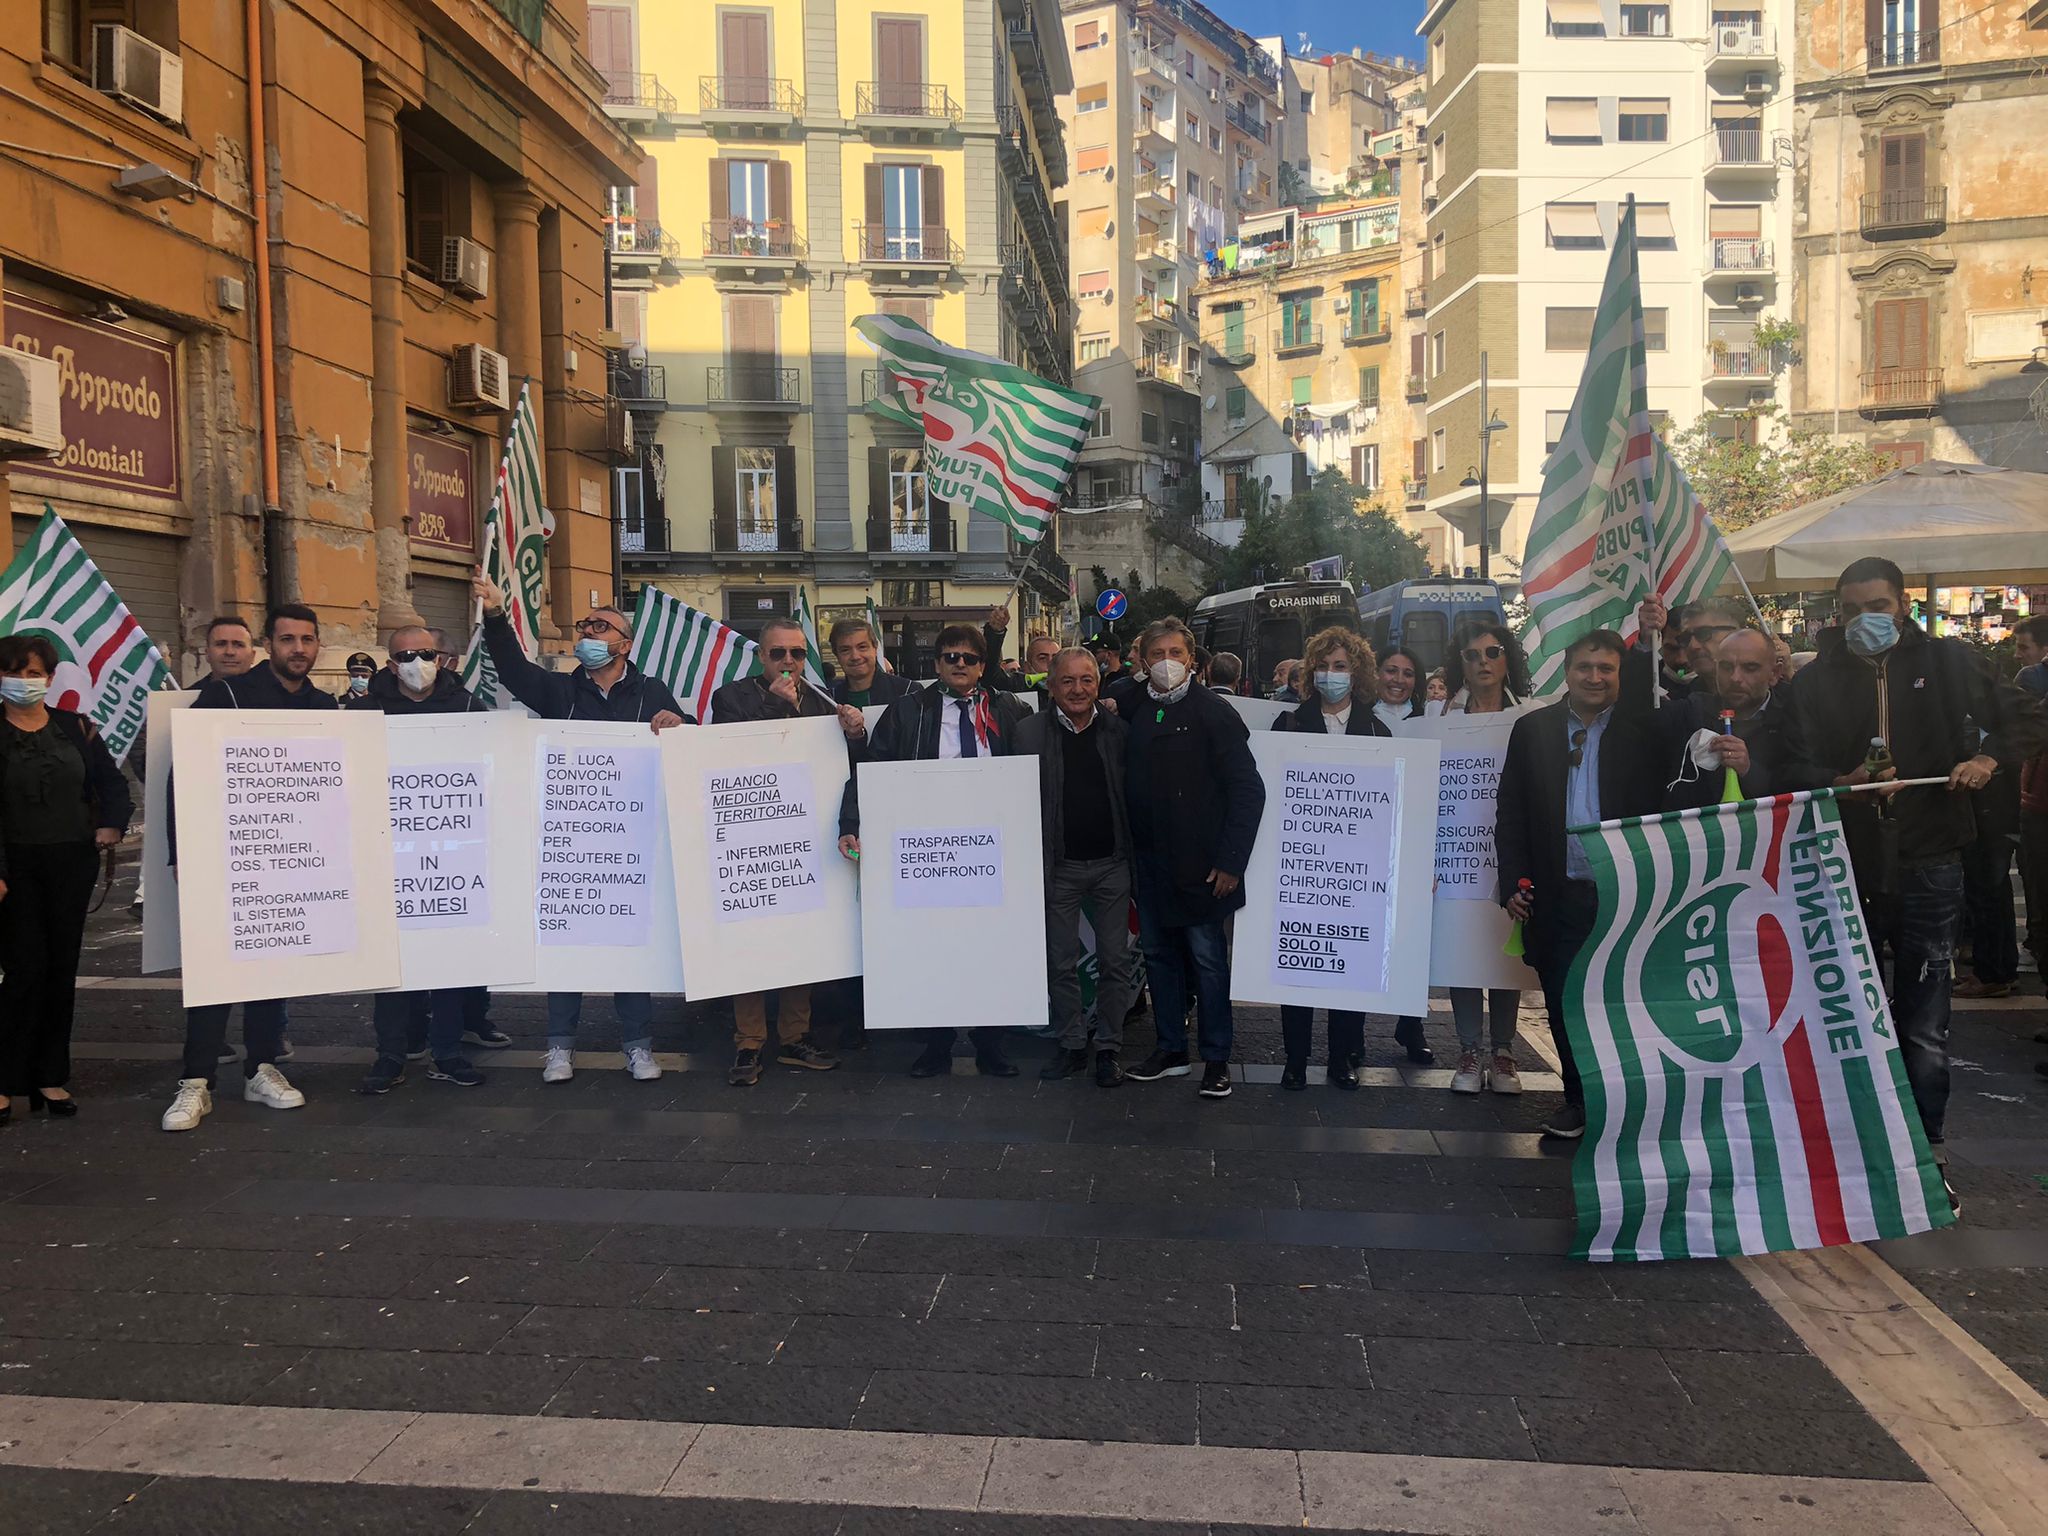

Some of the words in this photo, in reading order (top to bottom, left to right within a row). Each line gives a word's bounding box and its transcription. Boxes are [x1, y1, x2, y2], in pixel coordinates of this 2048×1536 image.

[52, 345, 161, 419] Approdo
[414, 453, 465, 498] Approdo
[419, 512, 450, 542] BAR
[522, 548, 543, 610] CIS
[1269, 595, 1341, 608] CARABINIERI
[1419, 592, 1484, 602] POLIZIA
[226, 747, 270, 758] PIANO
[274, 747, 287, 758] DI
[226, 761, 341, 773] RECLUTAMENTO
[547, 754, 566, 765] DE
[578, 755, 615, 766] LUCA
[1440, 758, 1495, 770] PRECARI
[388, 773, 477, 789] ROROGA
[546, 769, 621, 781] CONVOCHI
[711, 773, 777, 790] RILANCIO
[1286, 771, 1355, 785] RILANCIO
[1440, 774, 1468, 786] ONO
[227, 776, 343, 789] STRAORDINARIO
[228, 793, 242, 804] DI
[247, 791, 320, 803] OPERAORI
[546, 785, 598, 796] SUBITO
[602, 786, 612, 796] IL
[1285, 787, 1390, 803] DELL'ATTIVITA
[1439, 790, 1467, 800] ONO
[418, 793, 475, 809] TUTTI
[479, 793, 483, 807] I
[712, 789, 781, 807] MEDICINA
[545, 800, 626, 812] SINDACATO
[631, 801, 643, 812] DI
[714, 802, 807, 823] TERRITORIAL
[1291, 804, 1373, 819] ORDINARIA
[1439, 805, 1456, 816] ER
[229, 813, 294, 825] SANITARI
[544, 821, 625, 833] CATEGORIA
[716, 827, 726, 840] E
[1283, 820, 1297, 831] DI
[1301, 821, 1343, 834] CURA
[1348, 824, 1357, 835] E
[543, 837, 572, 847] PER
[900, 835, 994, 848] TRASPARENZA
[1282, 842, 1325, 855] DEGLI
[1435, 842, 1491, 852] ITTADINI
[230, 842, 312, 856] INFERMIERI
[726, 840, 811, 861] INFERMIERE
[270, 856, 325, 870] TECNICI
[420, 856, 439, 870] IN
[542, 852, 622, 864] DISCUTERE
[627, 853, 640, 864] DI
[900, 851, 958, 864] SERIETA'
[719, 867, 733, 879] DI
[737, 858, 803, 877] FAMIGLIA
[901, 868, 909, 879] E
[913, 865, 995, 878] CONFRONTO
[1281, 858, 1368, 875] INTERVENTI
[394, 875, 466, 893] ERVIZIO
[472, 875, 484, 889] A
[541, 873, 646, 884] PROGRAMMAZI
[729, 880, 767, 894] CASE
[772, 873, 815, 889] DELLA
[1280, 875, 1367, 892] CHIRURGICI
[1372, 882, 1386, 893] IN
[1434, 873, 1477, 884] ALUTE
[232, 881, 259, 893] PER
[540, 888, 570, 899] ONE
[575, 889, 583, 899] E
[588, 889, 601, 899] DI
[232, 890, 349, 907] RIPROGRAMMARE
[420, 897, 467, 913] MESI
[723, 894, 777, 912] SALUTE
[1279, 892, 1355, 907] ELEZIONE.
[234, 912, 244, 921] IL
[248, 907, 306, 920] SISTEMA
[540, 904, 605, 915] RILANCIO
[610, 905, 636, 915] DEL
[234, 920, 305, 936] SANITARIO
[539, 919, 571, 930] SSR.
[1280, 921, 1312, 933] NON
[1317, 924, 1369, 938] ESISTE
[235, 934, 312, 950] REGIONALE
[1279, 938, 1320, 951] SOLO
[1325, 941, 1337, 953] IL
[1278, 955, 1324, 969] COVID
[1329, 958, 1345, 971] 19
